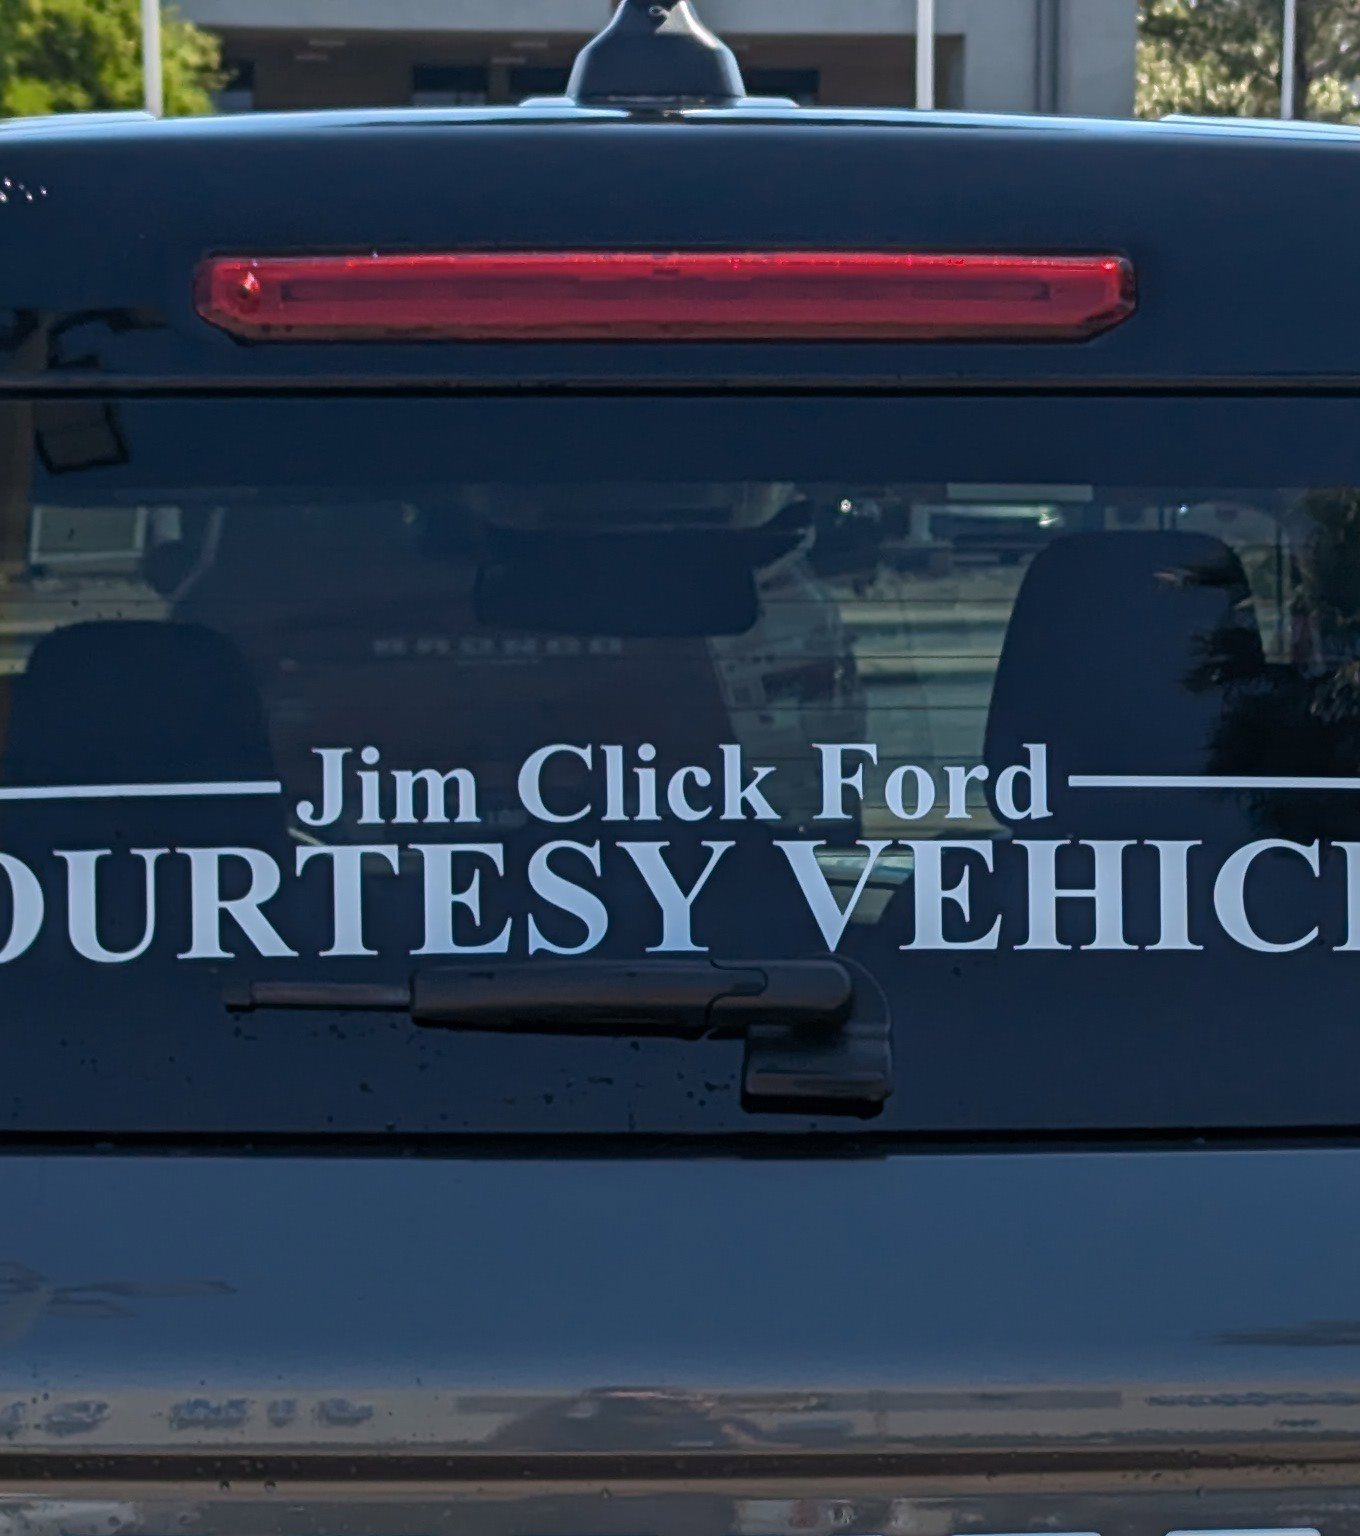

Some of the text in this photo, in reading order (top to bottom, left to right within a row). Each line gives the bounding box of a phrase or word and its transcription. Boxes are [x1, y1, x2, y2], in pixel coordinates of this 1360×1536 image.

[296, 742, 1054, 827] Jim Click Ford
